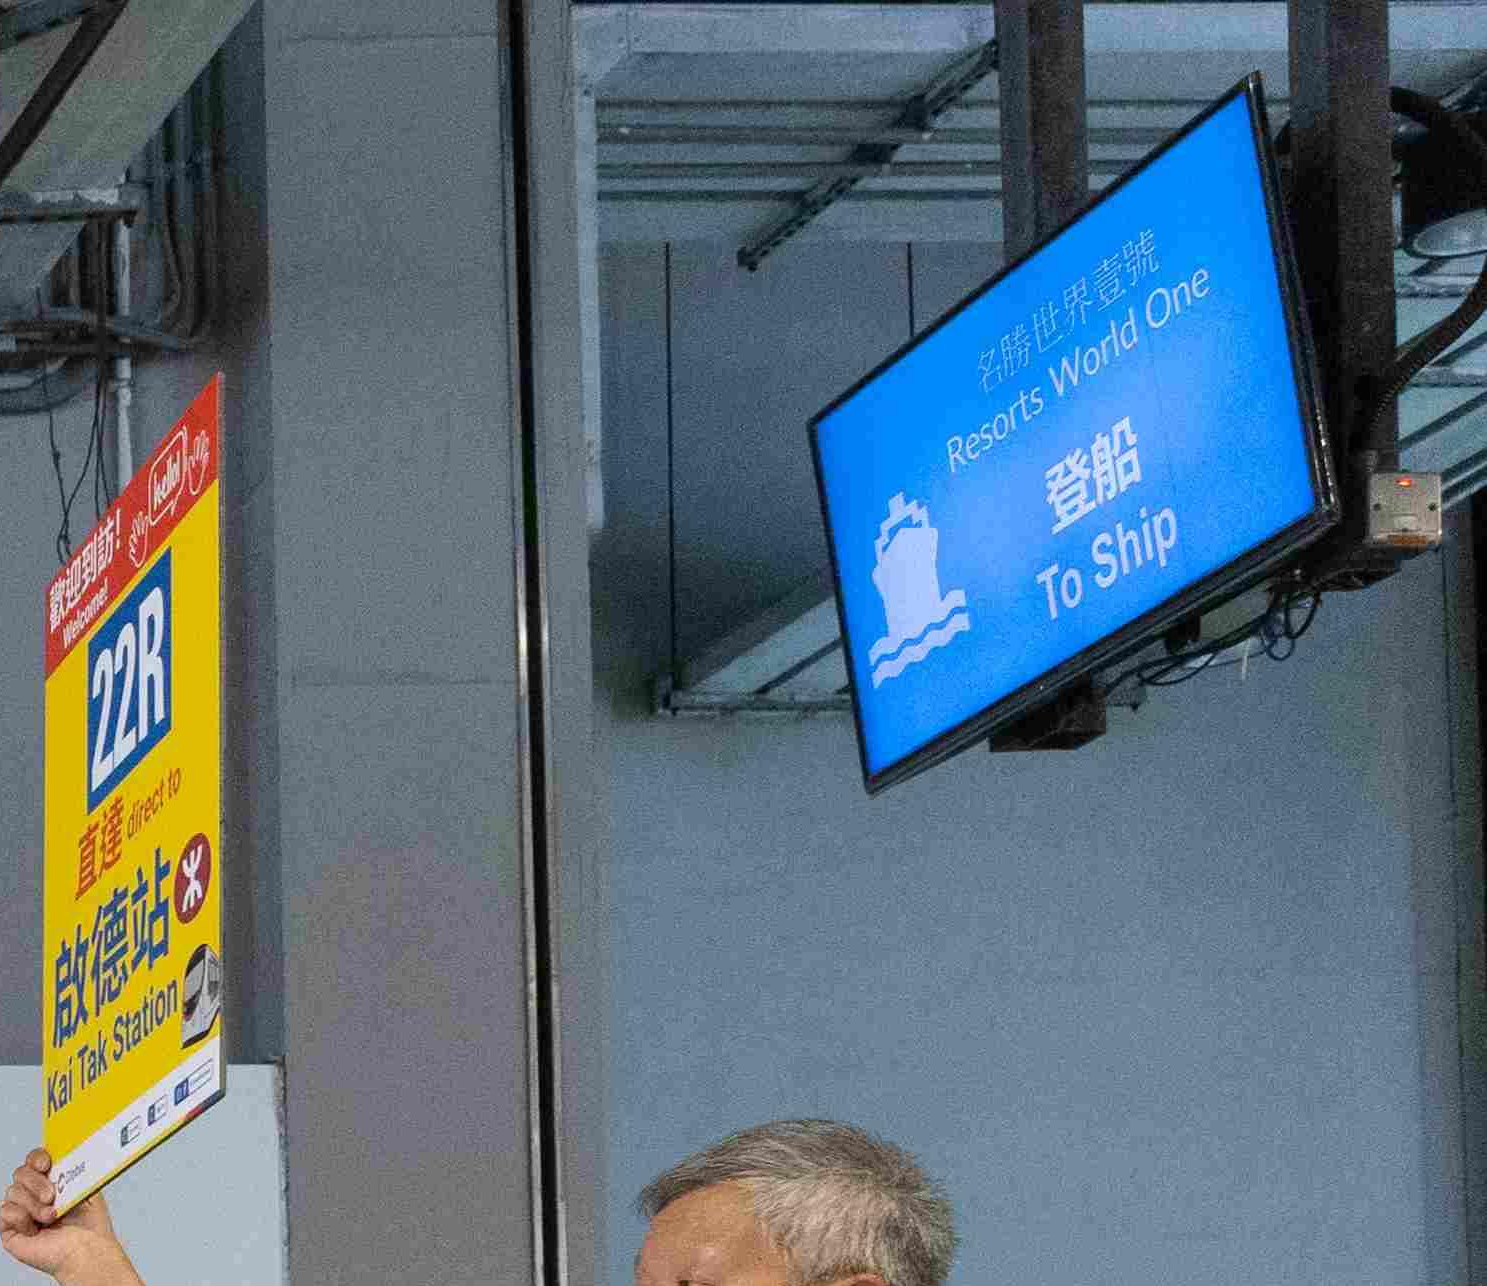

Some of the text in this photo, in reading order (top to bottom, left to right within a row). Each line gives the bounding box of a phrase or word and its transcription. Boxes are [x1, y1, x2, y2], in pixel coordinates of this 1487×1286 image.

[947, 267, 1212, 473] Resorts World One
[978, 228, 1159, 393] 名勝世界壹號
[1045, 416, 1142, 536] 登船
[62, 577, 109, 648] Welcome!
[1036, 506, 1177, 620] To Ship
[90, 585, 165, 795] 22R
[75, 796, 124, 901] 直達
[127, 767, 182, 840] direct to
[52, 846, 171, 1048] 啟德站
[46, 1056, 73, 1119] Kai
[77, 1029, 109, 1091] Tak
[112, 979, 178, 1062] Station
